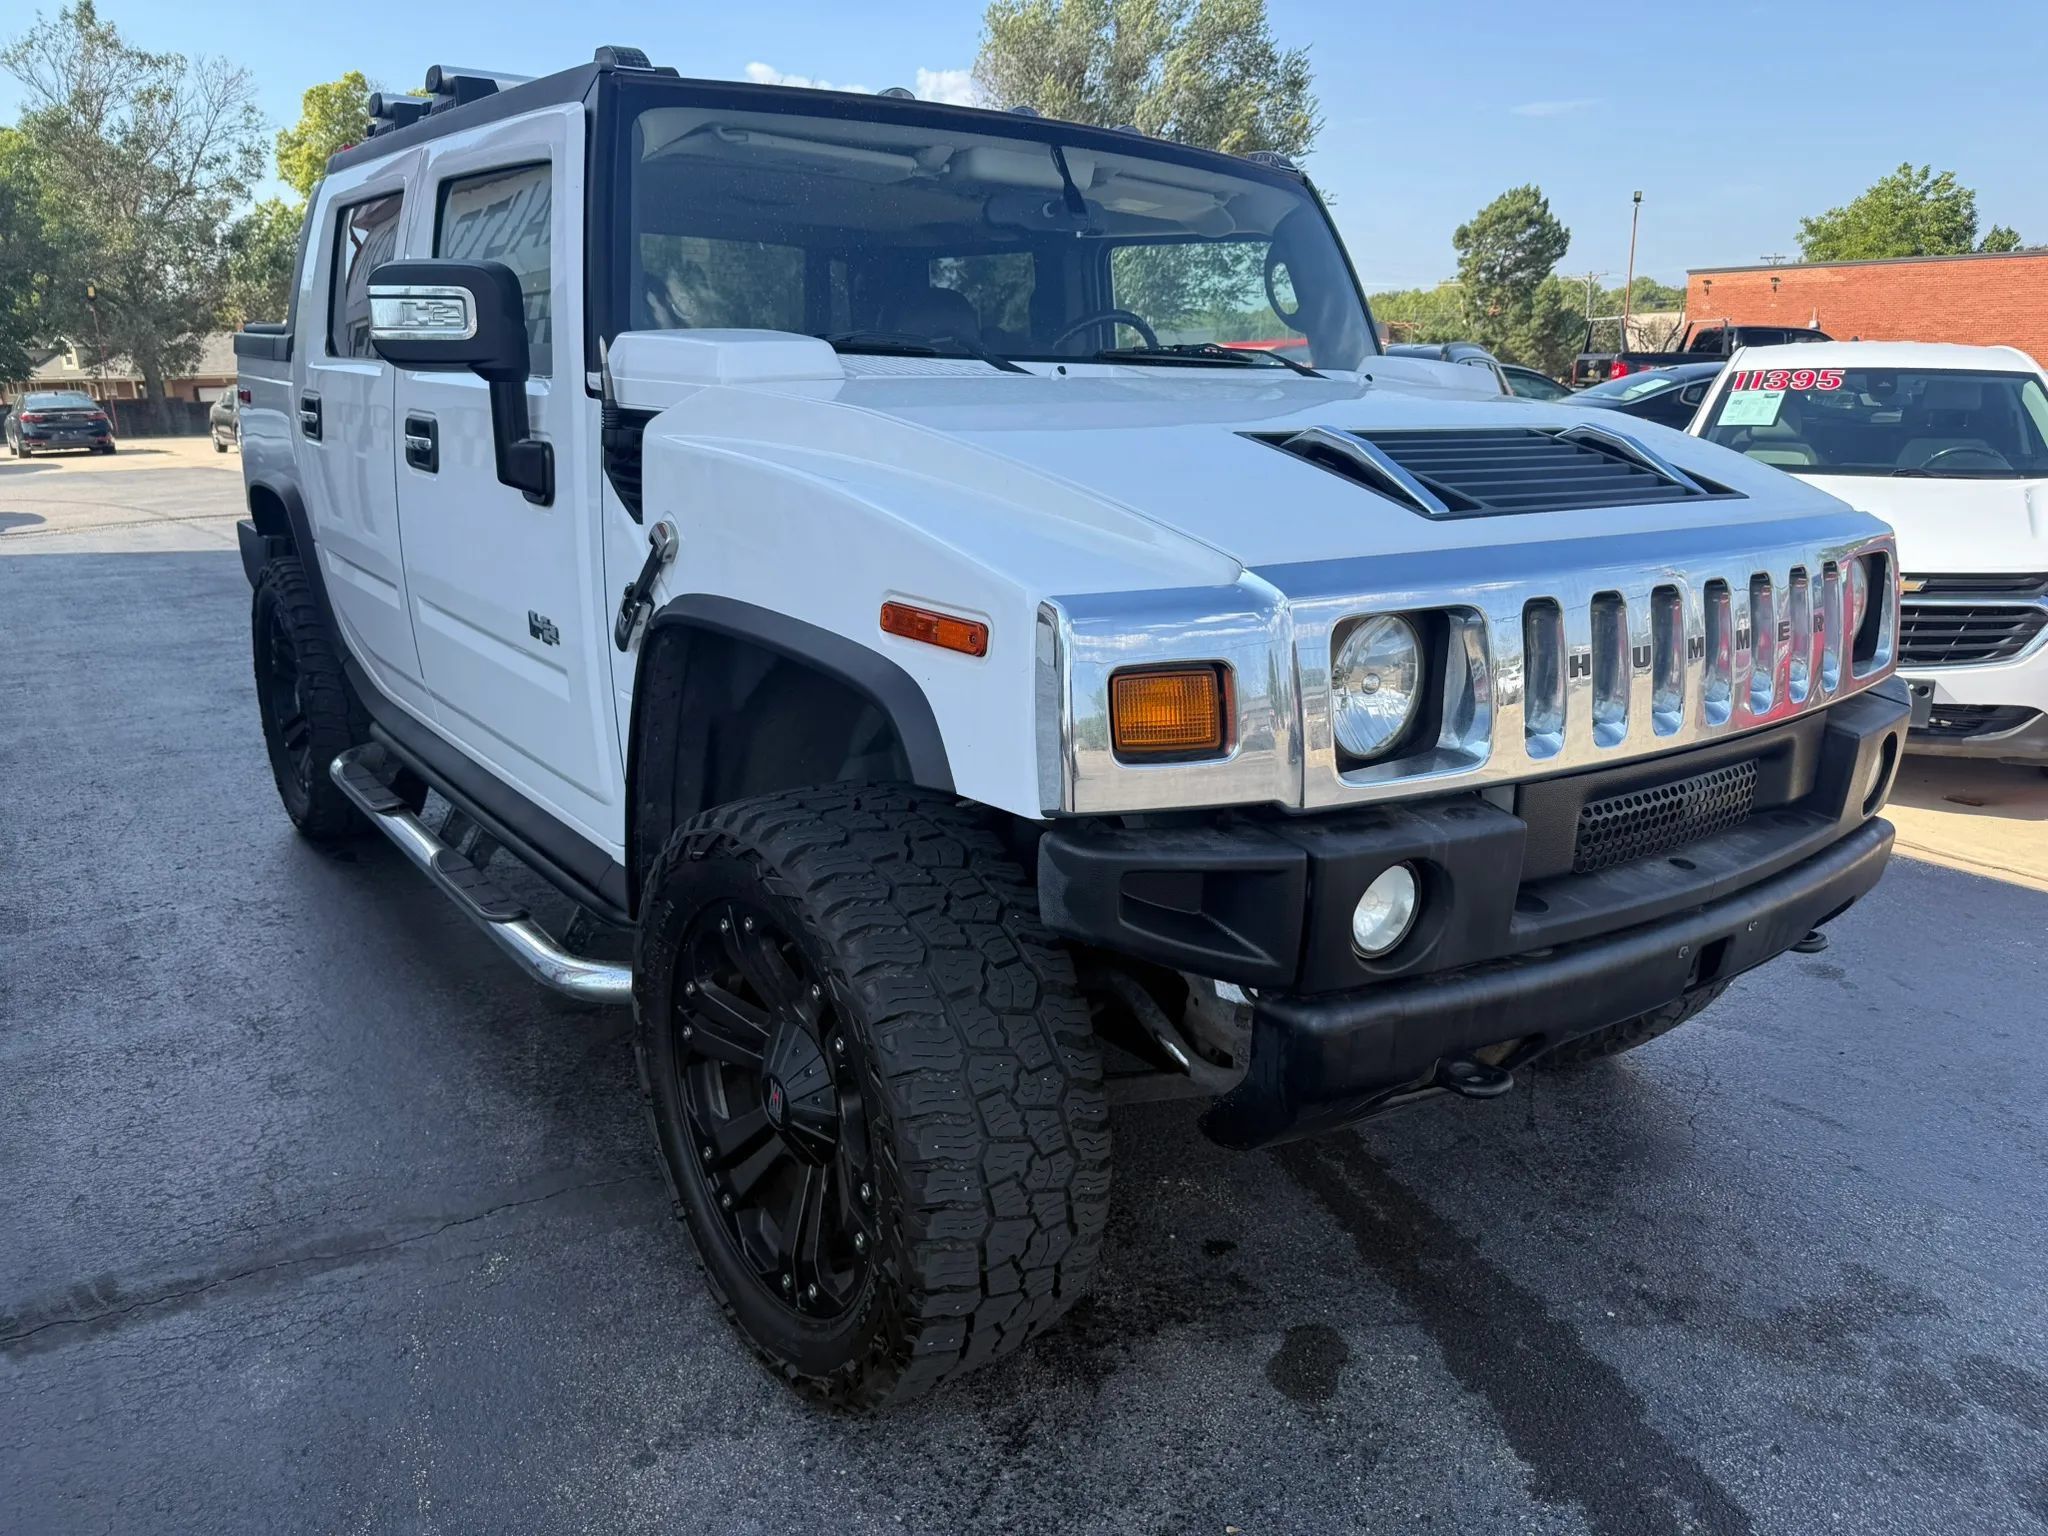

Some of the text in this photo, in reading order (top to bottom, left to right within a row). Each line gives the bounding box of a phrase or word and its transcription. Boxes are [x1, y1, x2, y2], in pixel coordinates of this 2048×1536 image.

[401, 301, 462, 326] H2
[1731, 369, 1846, 391] 11395
[1568, 614, 1824, 678] HUMMER
